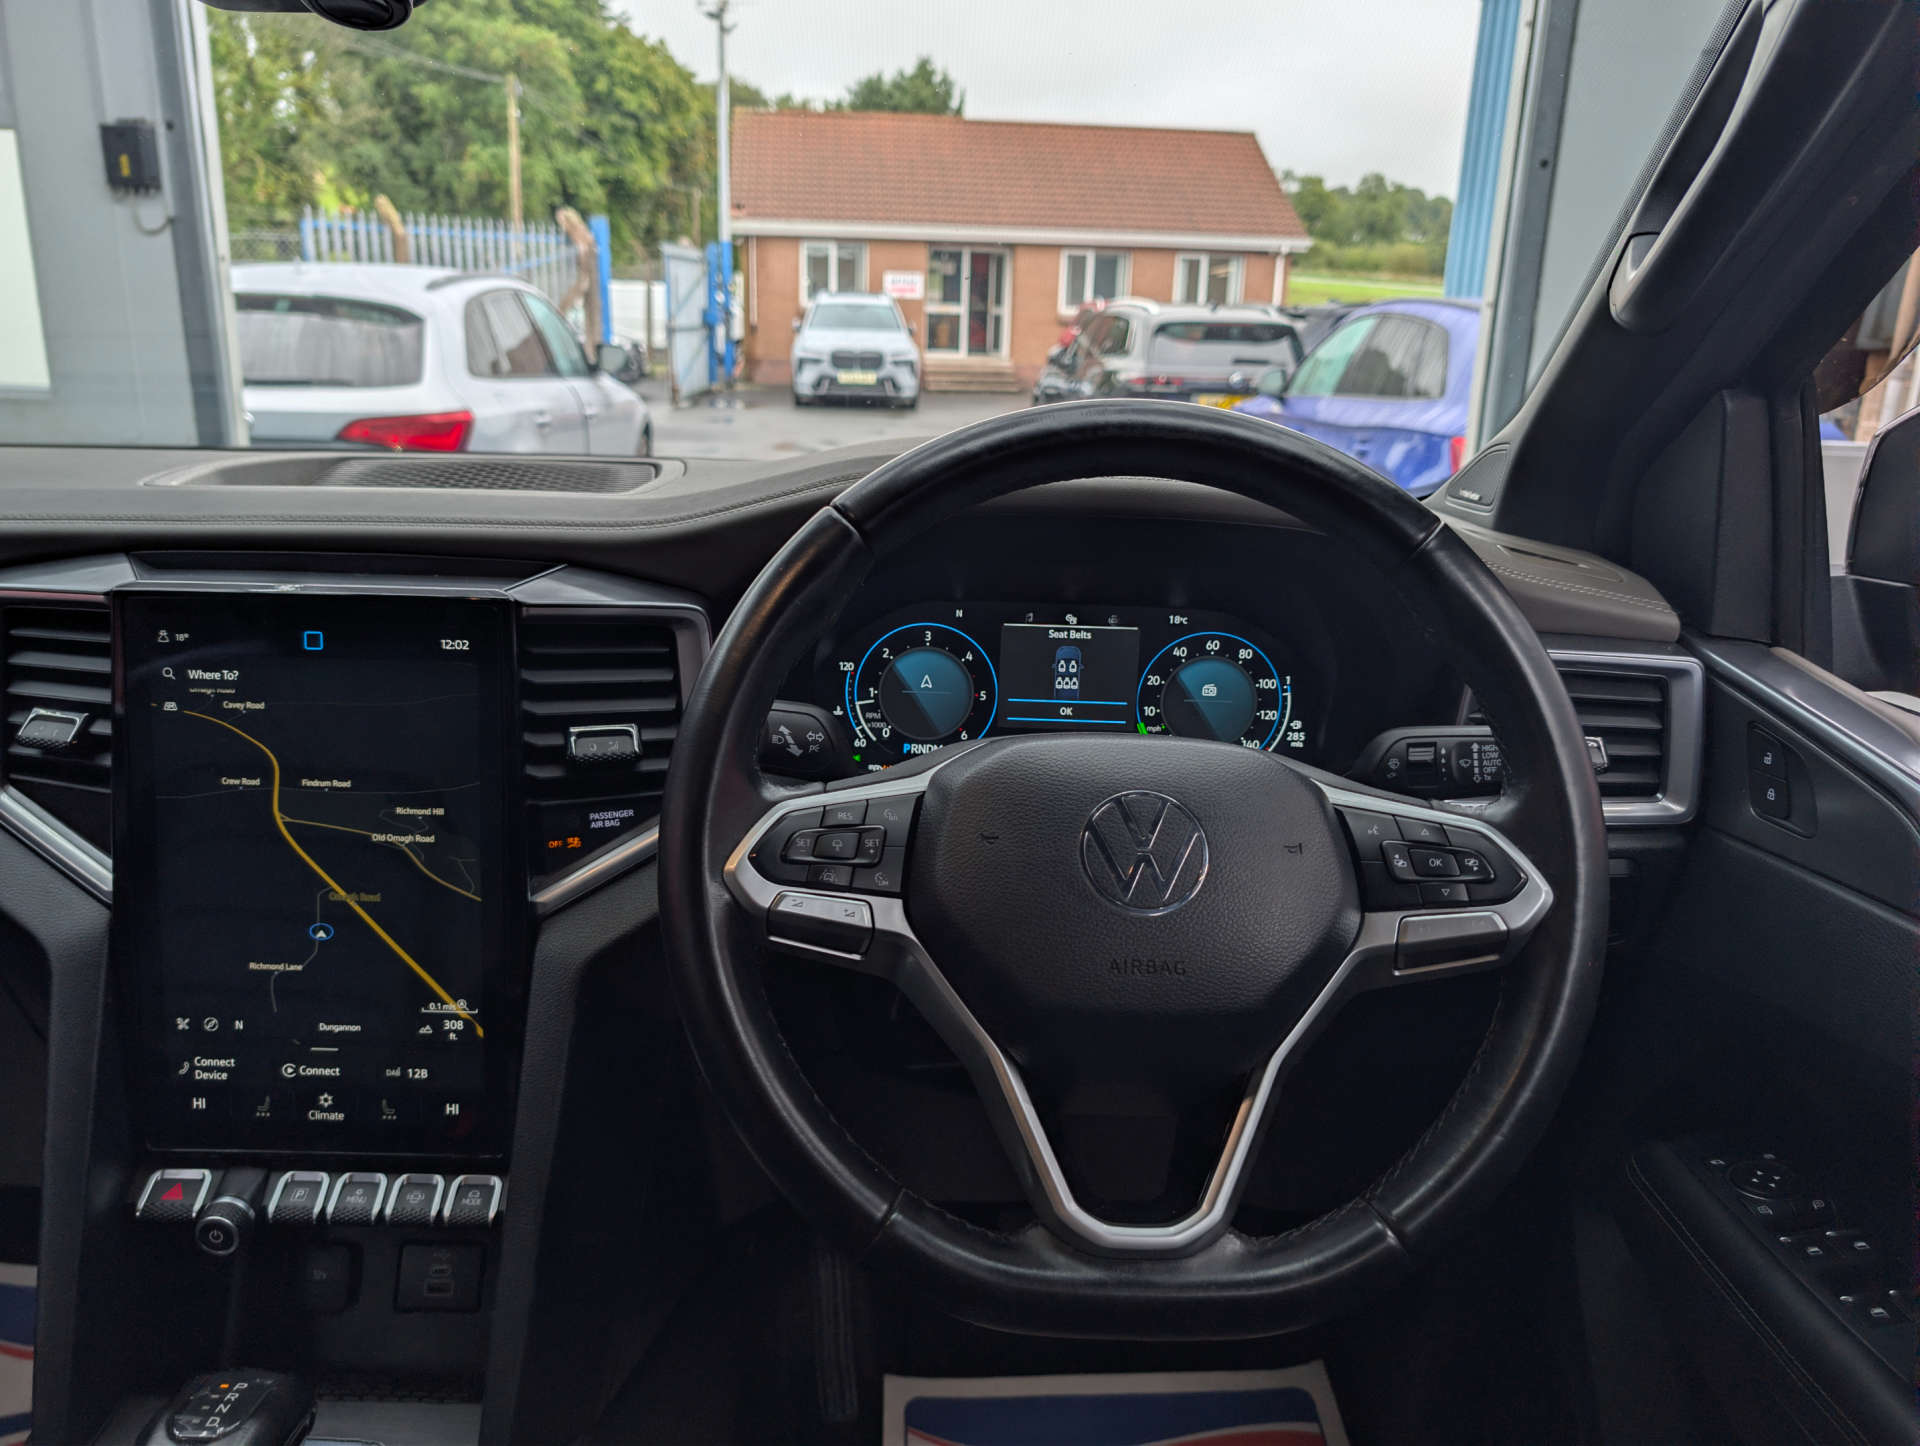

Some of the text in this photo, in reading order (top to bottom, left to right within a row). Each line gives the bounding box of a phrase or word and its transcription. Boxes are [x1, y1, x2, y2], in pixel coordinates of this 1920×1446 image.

[955, 609, 963, 618] N
[924, 631, 932, 641] 3
[1048, 630, 1092, 640] Seat Belts
[440, 639, 470, 650] 12:02
[1205, 640, 1220, 651] 60
[882, 648, 890, 658] 2
[965, 651, 973, 661] 4
[1172, 647, 1188, 657] 40
[1238, 648, 1253, 660] 80
[838, 662, 855, 671] 120
[187, 669, 239, 681] Where To?
[1146, 675, 1161, 686] 20
[1258, 679, 1277, 689] 100
[868, 688, 875, 697] 1
[979, 691, 987, 701] 5
[246, 701, 265, 710] Road
[1059, 707, 1073, 716] OK
[1143, 706, 1156, 716] 10
[1259, 710, 1278, 721] 120
[882, 728, 890, 738] 0
[1146, 725, 1161, 734] mph
[960, 731, 968, 740] 6
[1286, 732, 1305, 741] 285
[853, 738, 867, 748] 60
[1483, 766, 1497, 774] OFF
[238, 777, 260, 787] Road
[302, 778, 351, 788] Findrum Road
[396, 806, 445, 816] Richmond Hill
[589, 809, 635, 820] PASSENGER
[590, 819, 621, 829] AIR BAG
[372, 833, 435, 845] Old Omagh Road
[795, 838, 812, 847] SET
[864, 838, 880, 848] SET
[1428, 858, 1443, 867] OK
[249, 962, 303, 972] Richmond Lane
[1108, 959, 1187, 977] AIRBAG
[428, 1002, 442, 1010] 0.1
[234, 1020, 243, 1030] N
[319, 1022, 361, 1033] Dungannon
[443, 1020, 464, 1031] 308
[194, 1056, 235, 1068] Connect
[194, 1069, 228, 1081] Device
[299, 1064, 340, 1076] Connect
[192, 1098, 206, 1110] HI
[445, 1104, 459, 1115] HI
[308, 1109, 345, 1121] Climate
[233, 1382, 249, 1391] P
[224, 1392, 240, 1402] R
[214, 1403, 232, 1414] N
